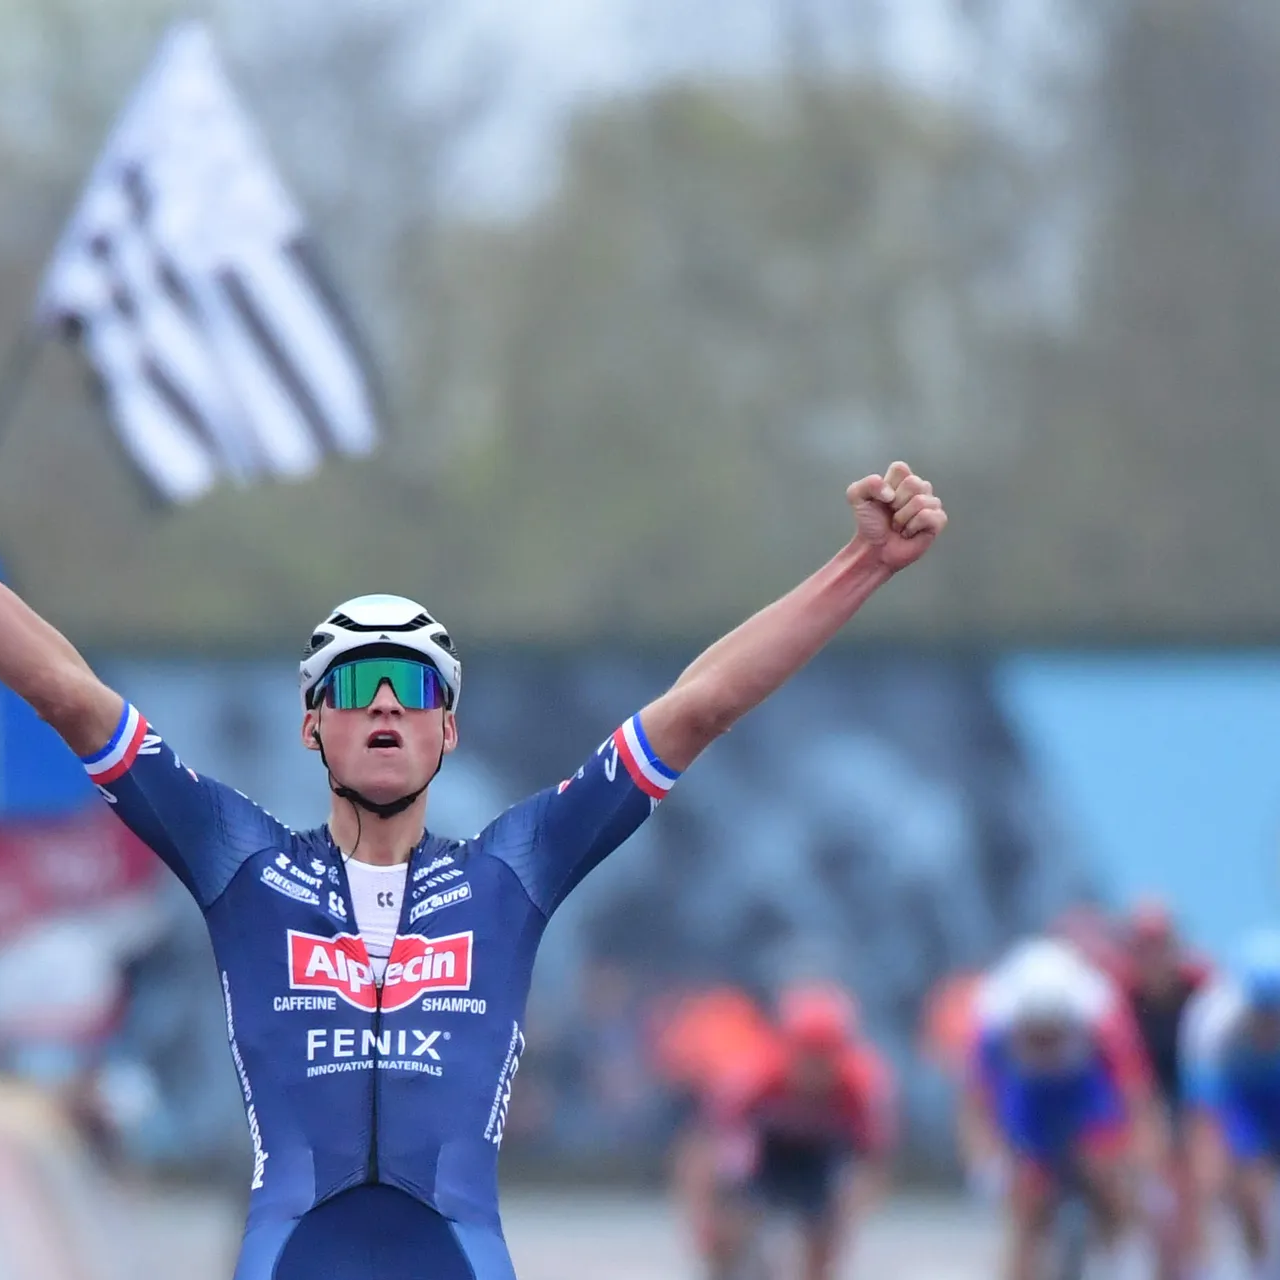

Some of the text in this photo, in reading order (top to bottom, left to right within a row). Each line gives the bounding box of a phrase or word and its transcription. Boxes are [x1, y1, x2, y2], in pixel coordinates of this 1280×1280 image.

[305, 945, 455, 993] Alpecin
[273, 996, 486, 1015] CAFFEINE SHAMPOO
[307, 1028, 442, 1061] FENIX
[307, 1060, 443, 1077] INNOVATIVE MATERIALS
